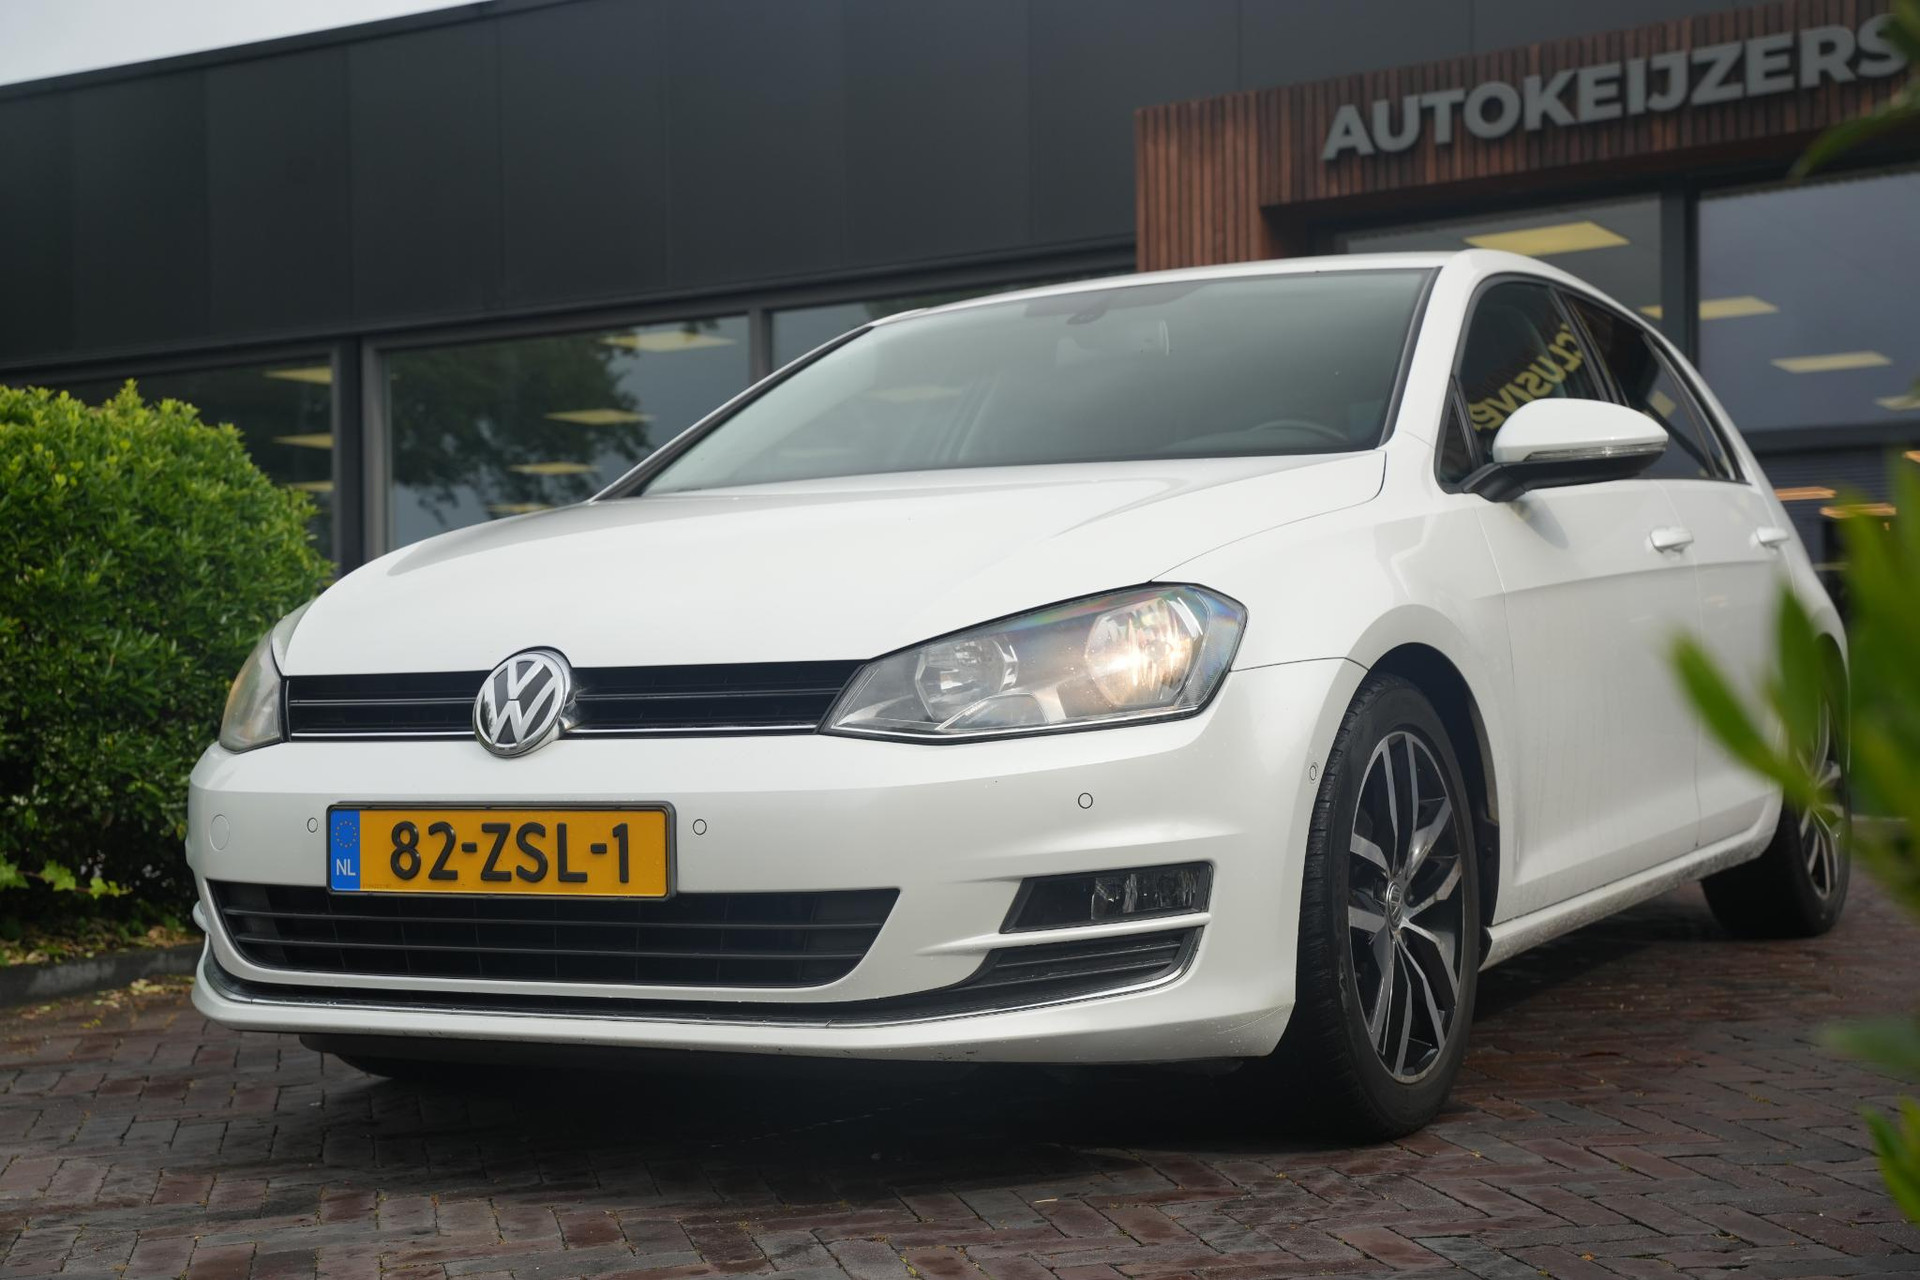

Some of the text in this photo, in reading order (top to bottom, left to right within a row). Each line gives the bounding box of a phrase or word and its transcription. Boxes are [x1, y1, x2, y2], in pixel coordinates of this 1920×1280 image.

[1321, 13, 1907, 161] AUTOKEIJZERS
[336, 858, 356, 877] NL
[390, 820, 630, 883] 82-ZSL-1
